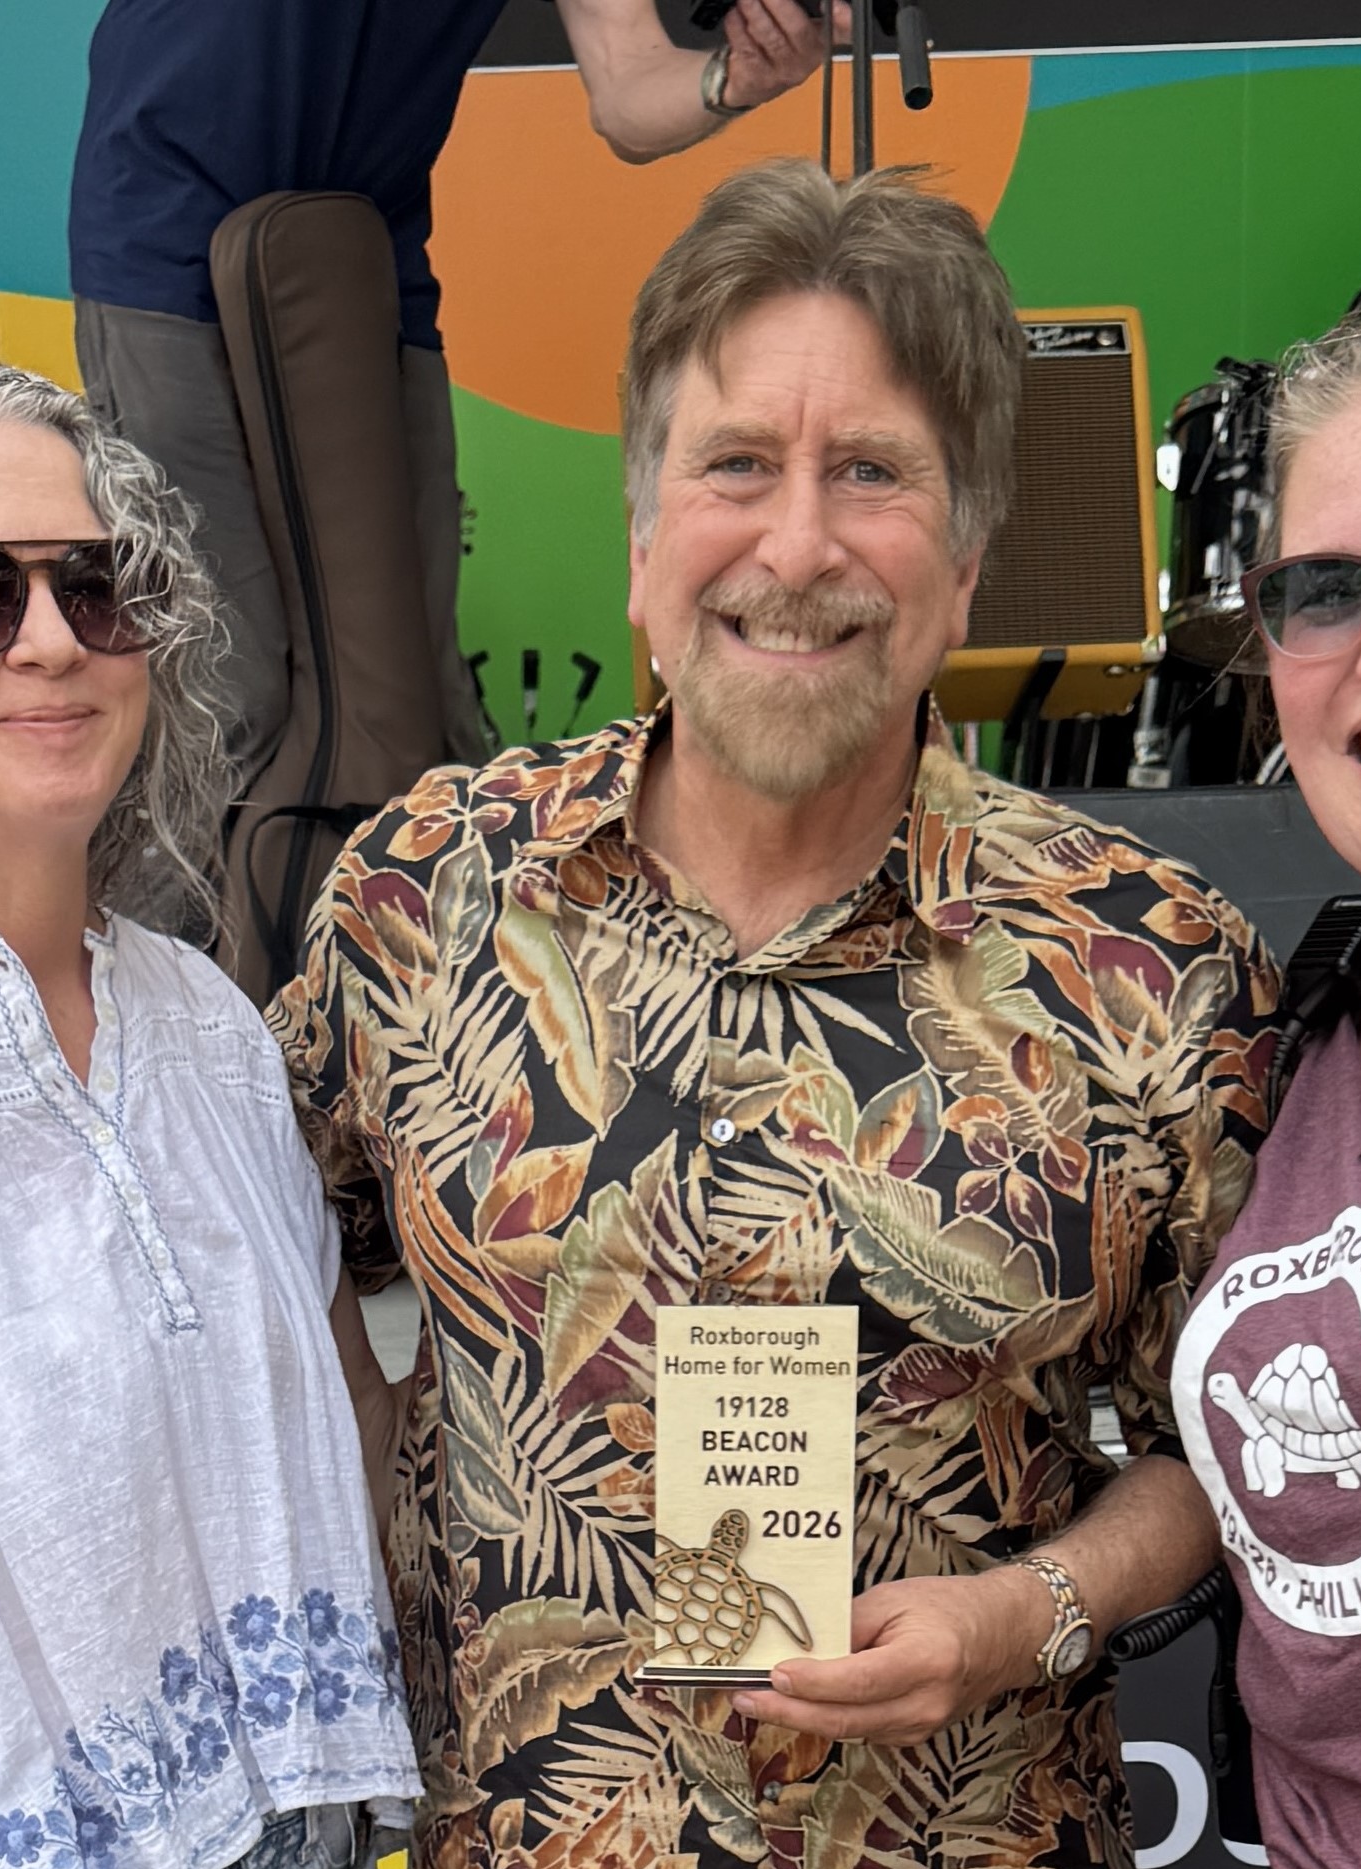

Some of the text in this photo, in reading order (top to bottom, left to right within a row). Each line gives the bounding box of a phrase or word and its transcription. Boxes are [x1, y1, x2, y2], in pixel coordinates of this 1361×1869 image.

[690, 1326, 820, 1350] Roxborough
[664, 1356, 851, 1376] Home for Women
[715, 1396, 789, 1418] 19128
[702, 1430, 808, 1453] BEACON
[704, 1465, 800, 1487] AWARD
[762, 1510, 842, 1539] 2026
